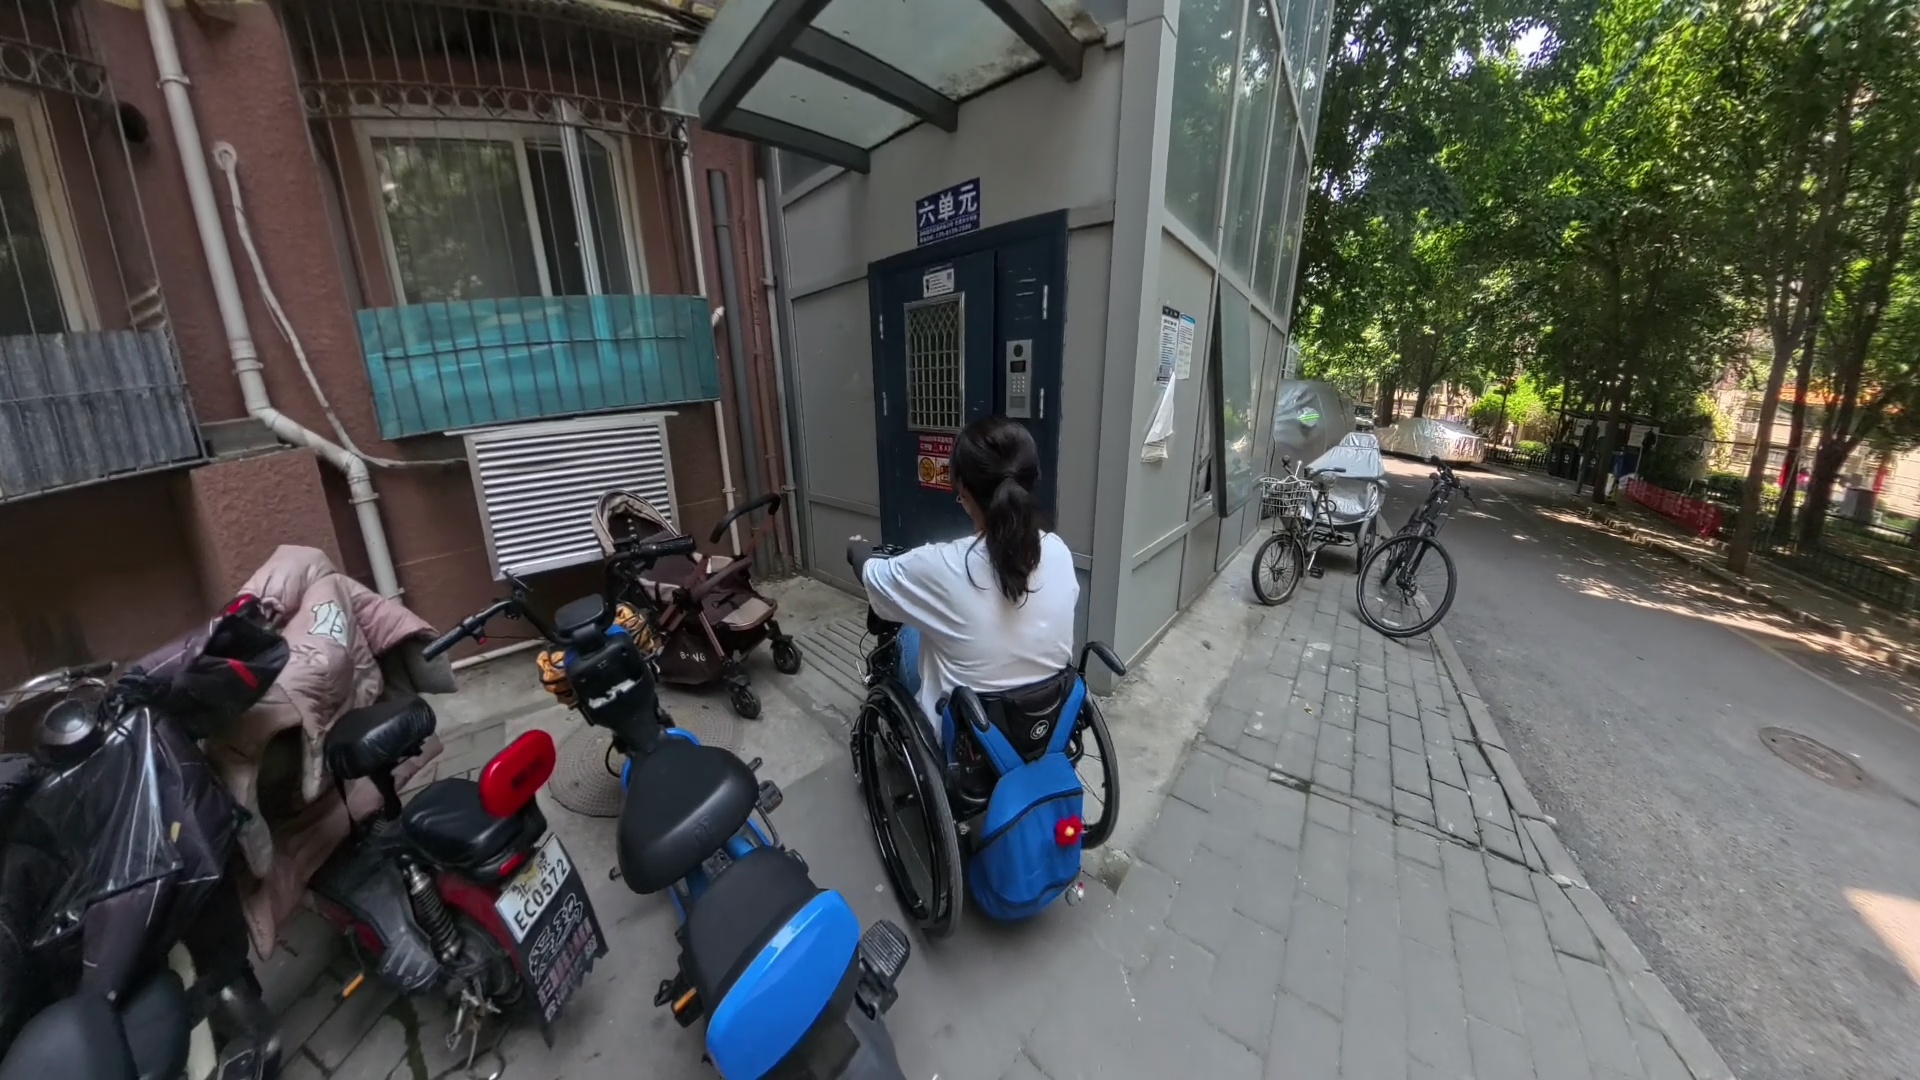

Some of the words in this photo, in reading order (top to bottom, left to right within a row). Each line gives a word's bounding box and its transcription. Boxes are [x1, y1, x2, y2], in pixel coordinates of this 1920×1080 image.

[918, 184, 977, 227] 六单元
[514, 859, 567, 930] EC0572
